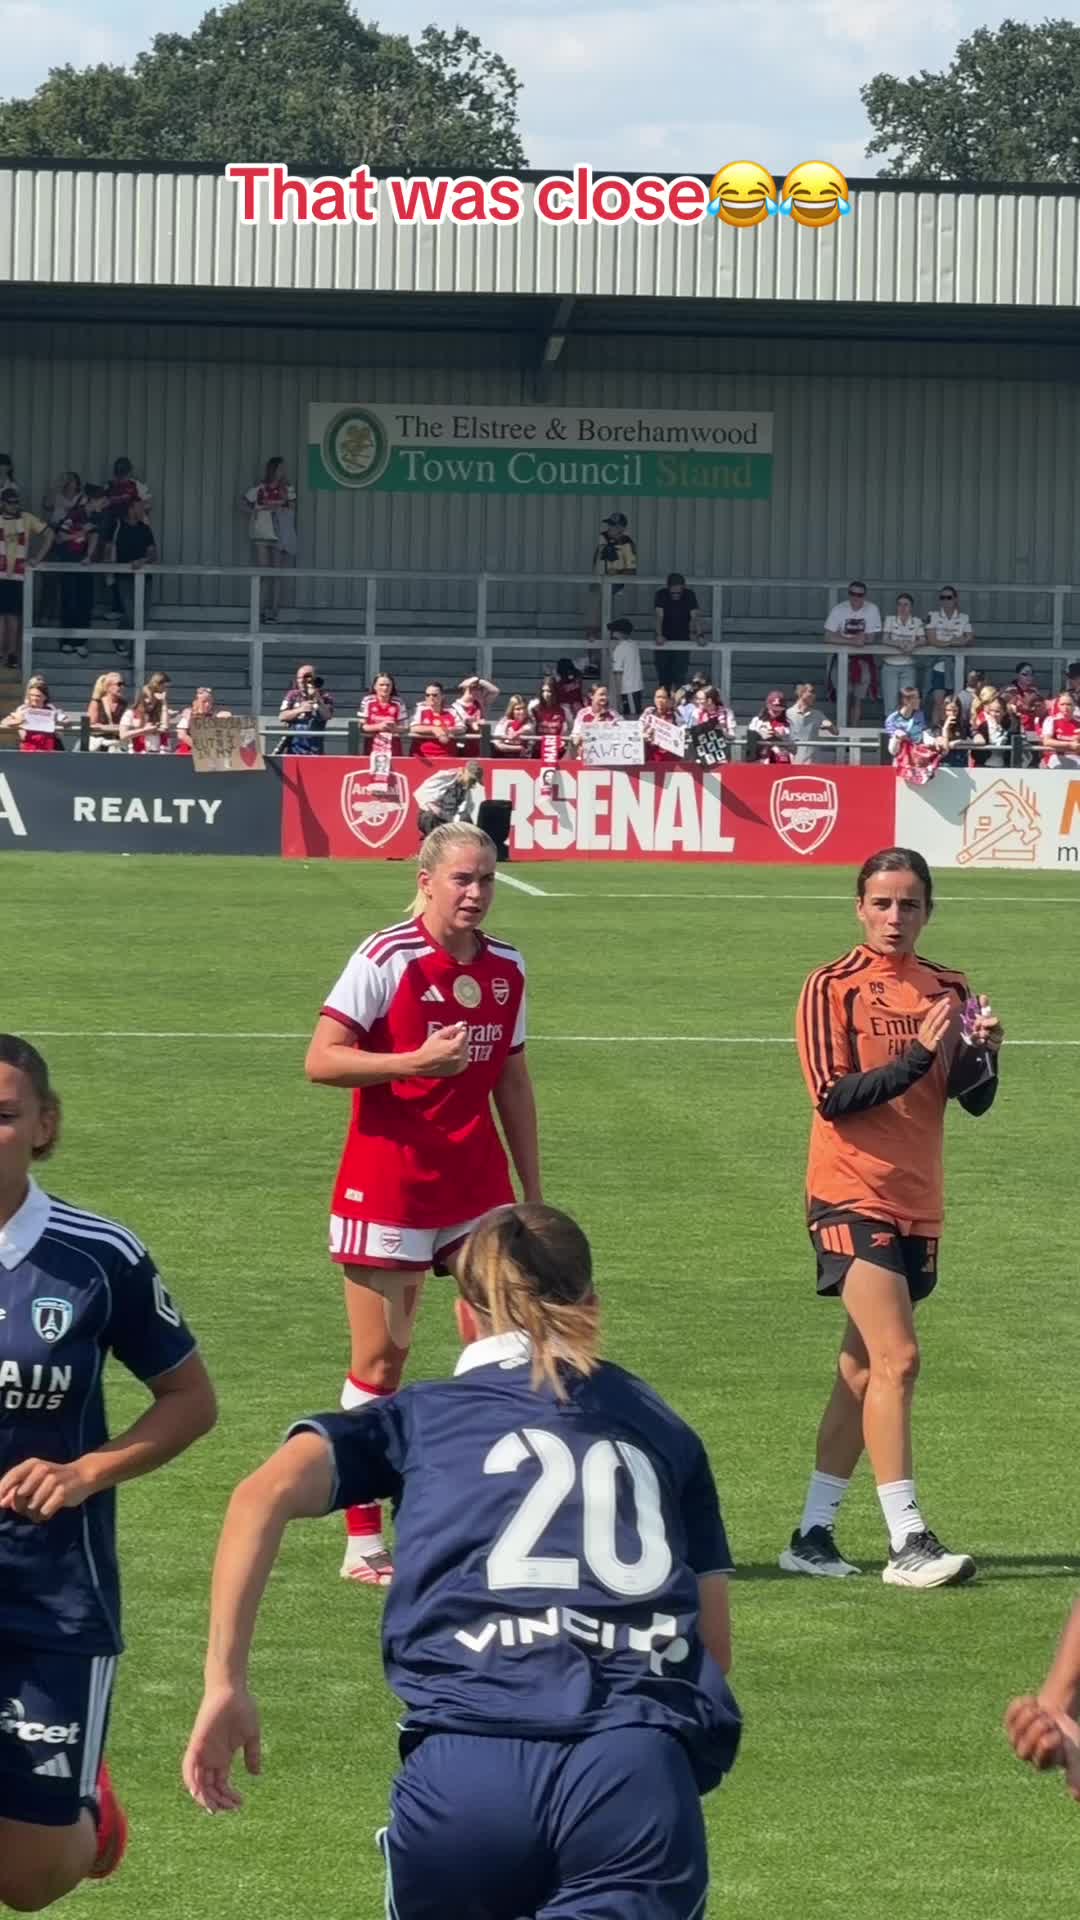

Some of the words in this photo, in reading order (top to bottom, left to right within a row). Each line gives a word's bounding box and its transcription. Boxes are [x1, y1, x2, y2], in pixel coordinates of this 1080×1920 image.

[395, 415, 443, 438] The
[452, 416, 537, 440] Elstree
[545, 417, 568, 441] &
[577, 418, 758, 445] Borehamwood
[399, 450, 495, 482] Town
[507, 451, 642, 486] Council
[656, 456, 752, 489] Stand
[73, 796, 222, 824] REALTY
[474, 768, 735, 852] RSENAL
[780, 789, 828, 802] Arsenal
[869, 981, 885, 995] RS
[870, 1014, 920, 1036] Emir
[483, 1428, 672, 1596] 20
[454, 1606, 616, 1653] VINCI
